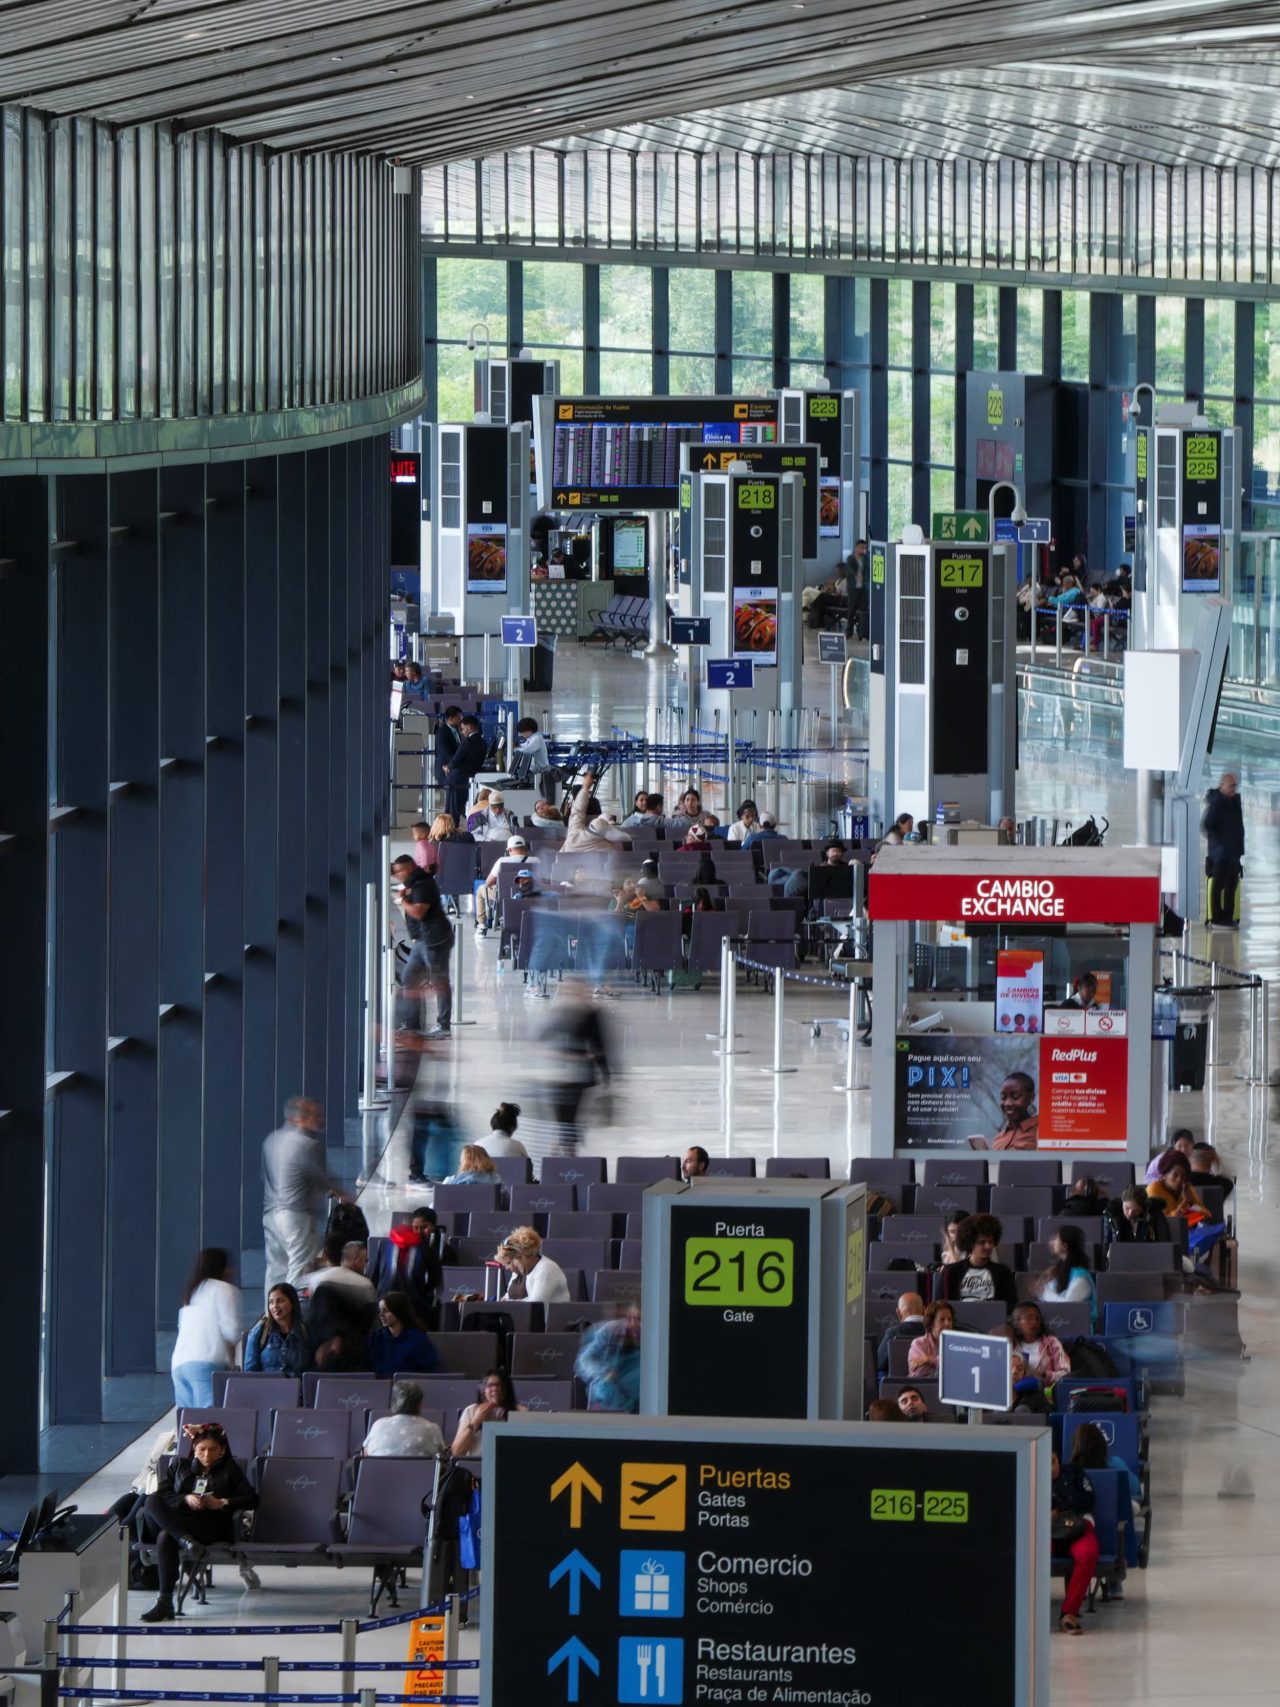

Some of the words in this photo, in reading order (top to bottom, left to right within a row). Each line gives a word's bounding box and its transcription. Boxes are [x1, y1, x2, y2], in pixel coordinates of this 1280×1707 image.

[812, 401, 836, 414] 223
[988, 397, 1002, 418] 223
[1188, 441, 1215, 454] 224
[1188, 462, 1215, 475] 225
[741, 489, 772, 505] 218
[1032, 528, 1037, 539] 1
[873, 559, 884, 580] 217
[944, 564, 981, 582] 217
[516, 628, 523, 641] 2
[688, 629, 694, 641] 1
[725, 671, 735, 685] 2
[976, 879, 1054, 898] CAMBIO
[961, 898, 1065, 917] EXCHANGE
[908, 1054, 931, 1063] Pague
[932, 1054, 949, 1063] aqui
[1051, 1048, 1098, 1063] RedPlus
[908, 1066, 969, 1087] PIX!
[1051, 1088, 1075, 1096] Compra
[715, 1221, 765, 1237] Puerta
[692, 1250, 786, 1294] 216
[723, 1309, 754, 1322] Gate
[948, 1343, 982, 1354] CopaAirlines
[970, 1366, 981, 1394] 1
[699, 1465, 791, 1489] Puertas
[698, 1491, 746, 1507] Gates
[698, 1511, 750, 1527] Portas
[697, 1550, 813, 1577] Comercio
[697, 1577, 748, 1597] Shops
[696, 1597, 774, 1615] Comércio
[697, 1638, 856, 1665] Restaurantes
[696, 1665, 793, 1682] Restaurants
[695, 1684, 742, 1704] Praça
[747, 1686, 767, 1701] de
[772, 1687, 872, 1707] Alimentação
